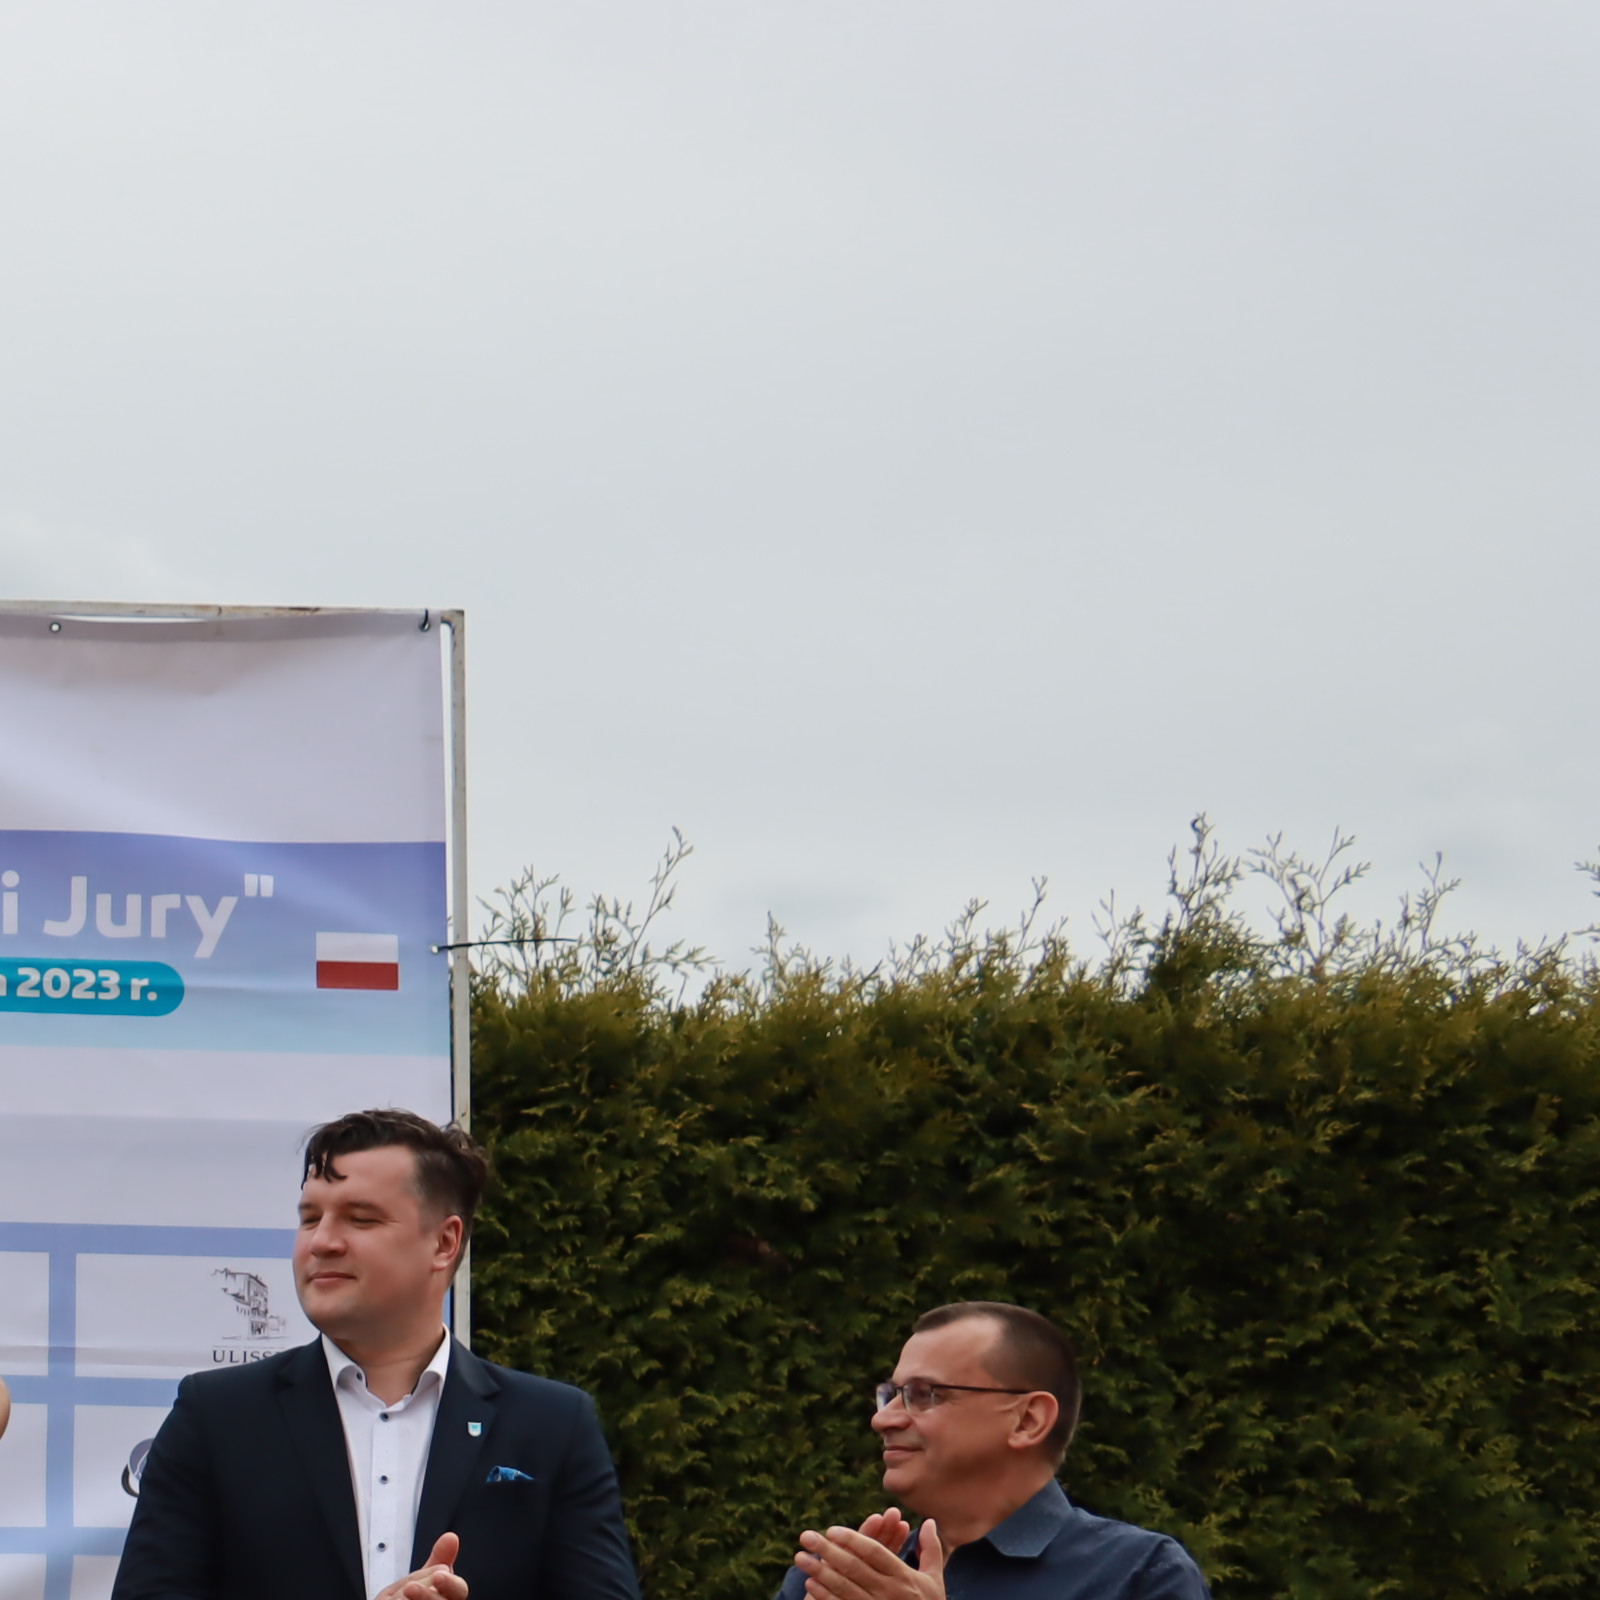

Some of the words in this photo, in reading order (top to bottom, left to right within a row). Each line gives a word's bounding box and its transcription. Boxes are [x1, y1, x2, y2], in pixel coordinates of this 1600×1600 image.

[42, 873, 275, 959] Jury"
[15, 966, 121, 1001] 2023
[130, 975, 158, 1002] r.
